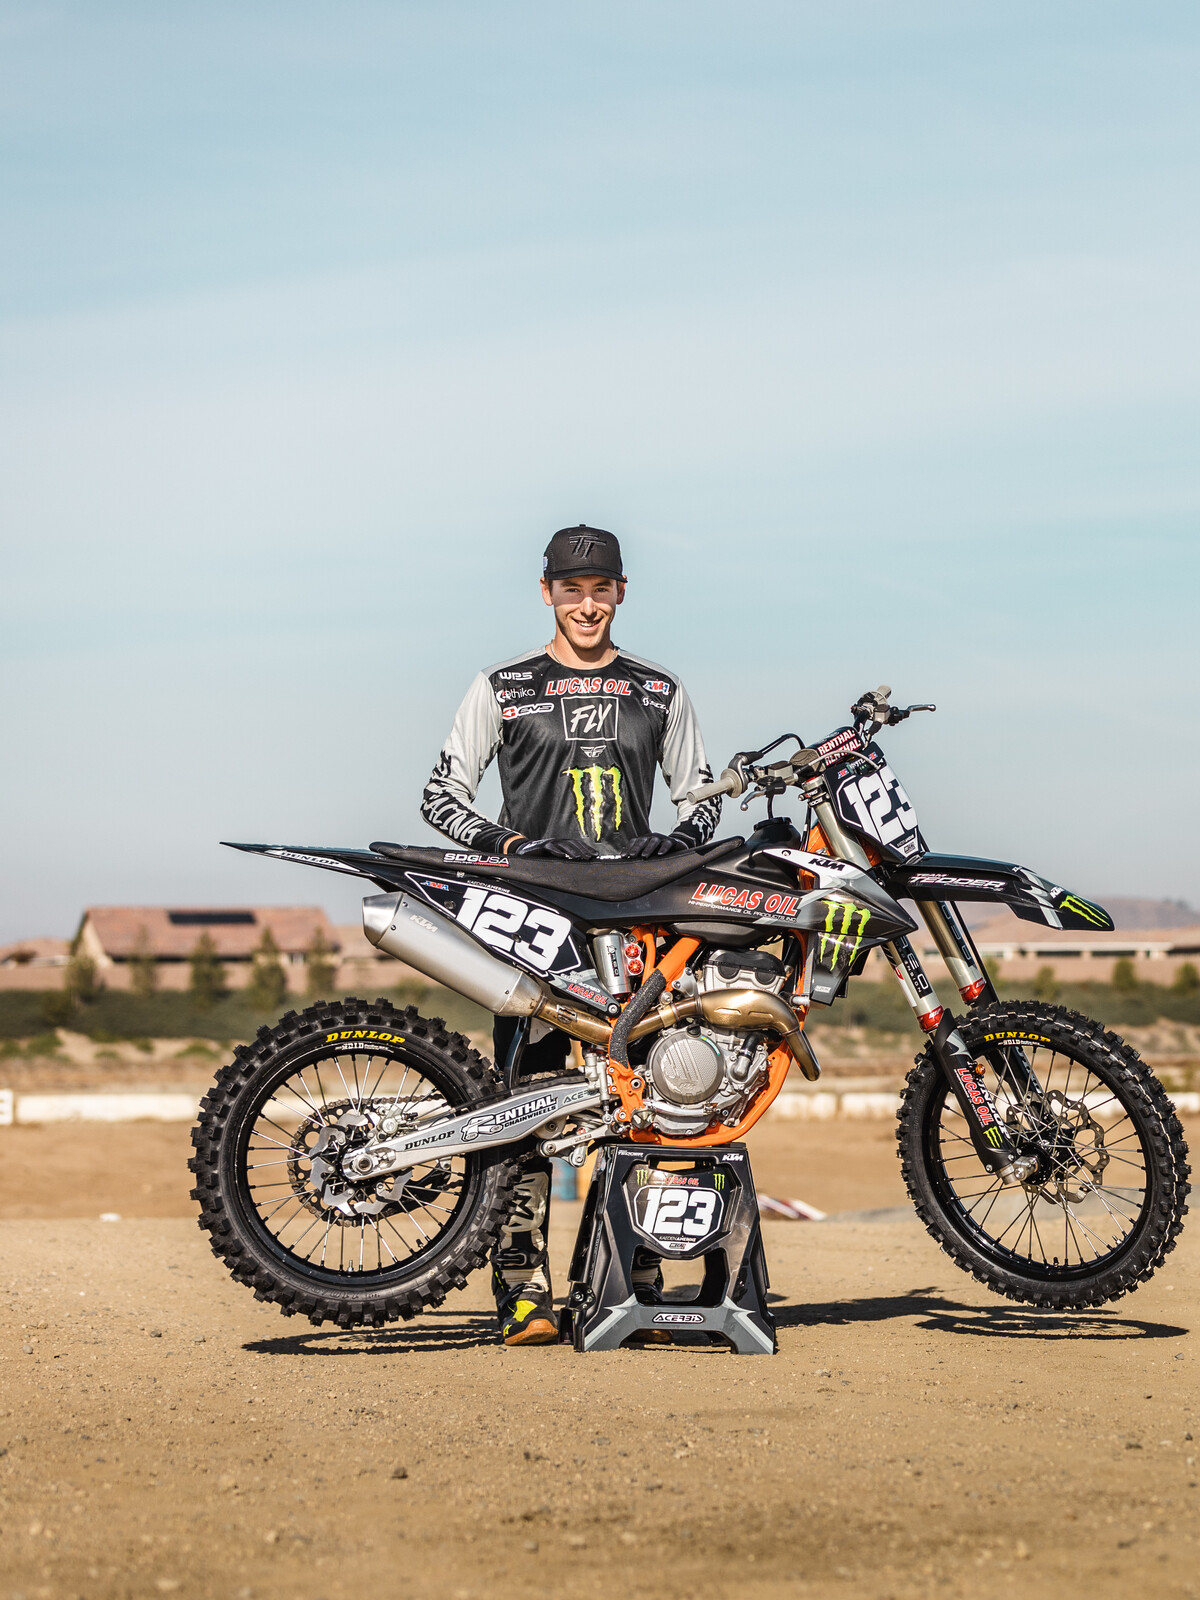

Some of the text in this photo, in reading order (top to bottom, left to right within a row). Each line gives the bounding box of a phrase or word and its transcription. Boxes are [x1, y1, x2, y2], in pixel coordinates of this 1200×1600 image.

[500, 672, 532, 681] WPS
[545, 677, 632, 696] LUCAS OIL
[570, 703, 612, 733] FLY
[817, 729, 856, 756] RENTHAL
[842, 763, 918, 846] 123
[808, 858, 846, 871] KTM
[909, 876, 1006, 888] TEDDER
[691, 882, 801, 917] LUCAS OIL
[454, 887, 572, 971] 123
[567, 983, 594, 999] LUCAS
[594, 992, 607, 1005] OIL
[326, 1030, 405, 1043] DUNLOP
[957, 1067, 994, 1126] LUCAS OIL
[504, 1105, 557, 1128] CHAINWHEELS
[405, 1130, 455, 1150] DUNLOP
[688, 1178, 700, 1186] OIL
[642, 1188, 716, 1236] 123
